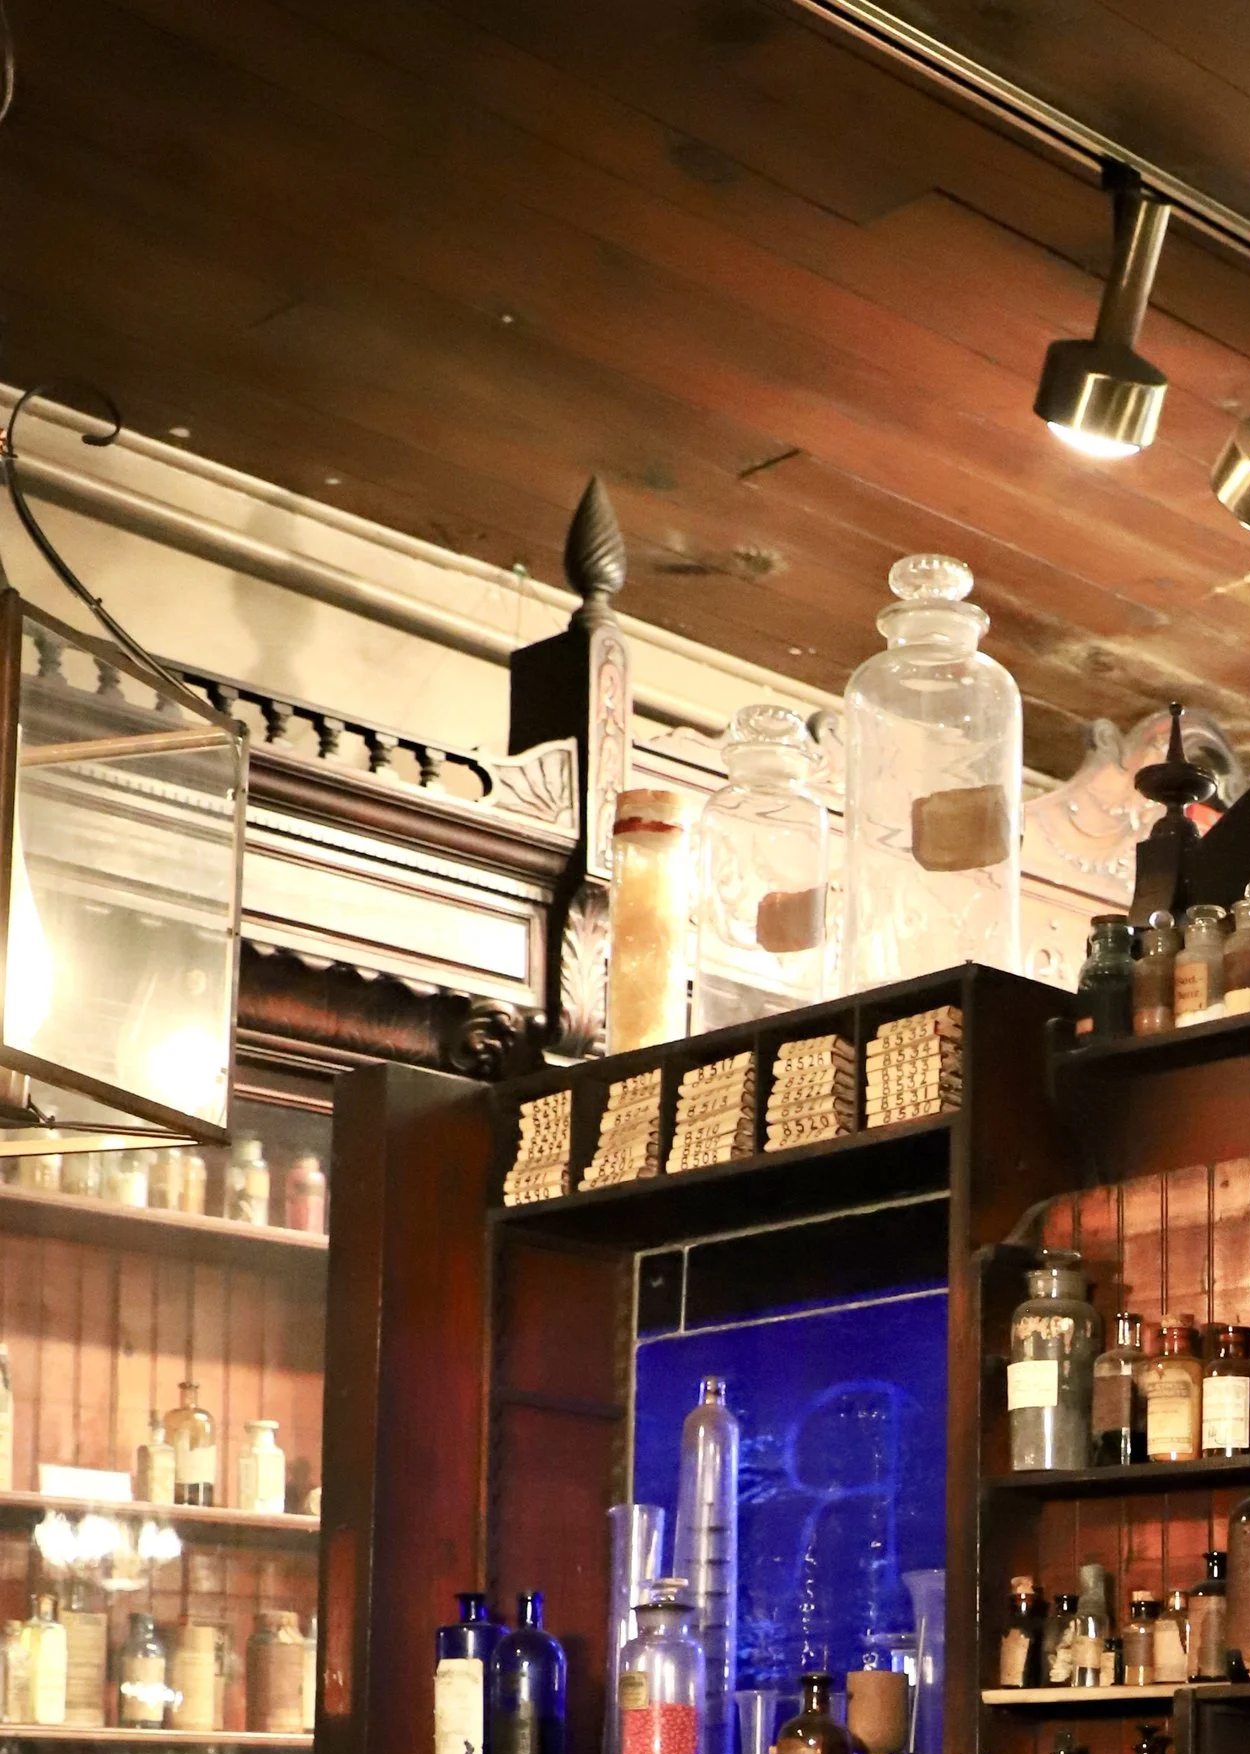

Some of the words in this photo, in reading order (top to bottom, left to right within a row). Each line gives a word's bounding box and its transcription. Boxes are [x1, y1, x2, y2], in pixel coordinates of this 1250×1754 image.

[882, 1024, 928, 1050] 8535
[882, 1041, 932, 1066] 8534
[882, 1072, 927, 1096] 8532
[880, 1086, 928, 1110] 8531
[781, 1115, 829, 1137] 8520
